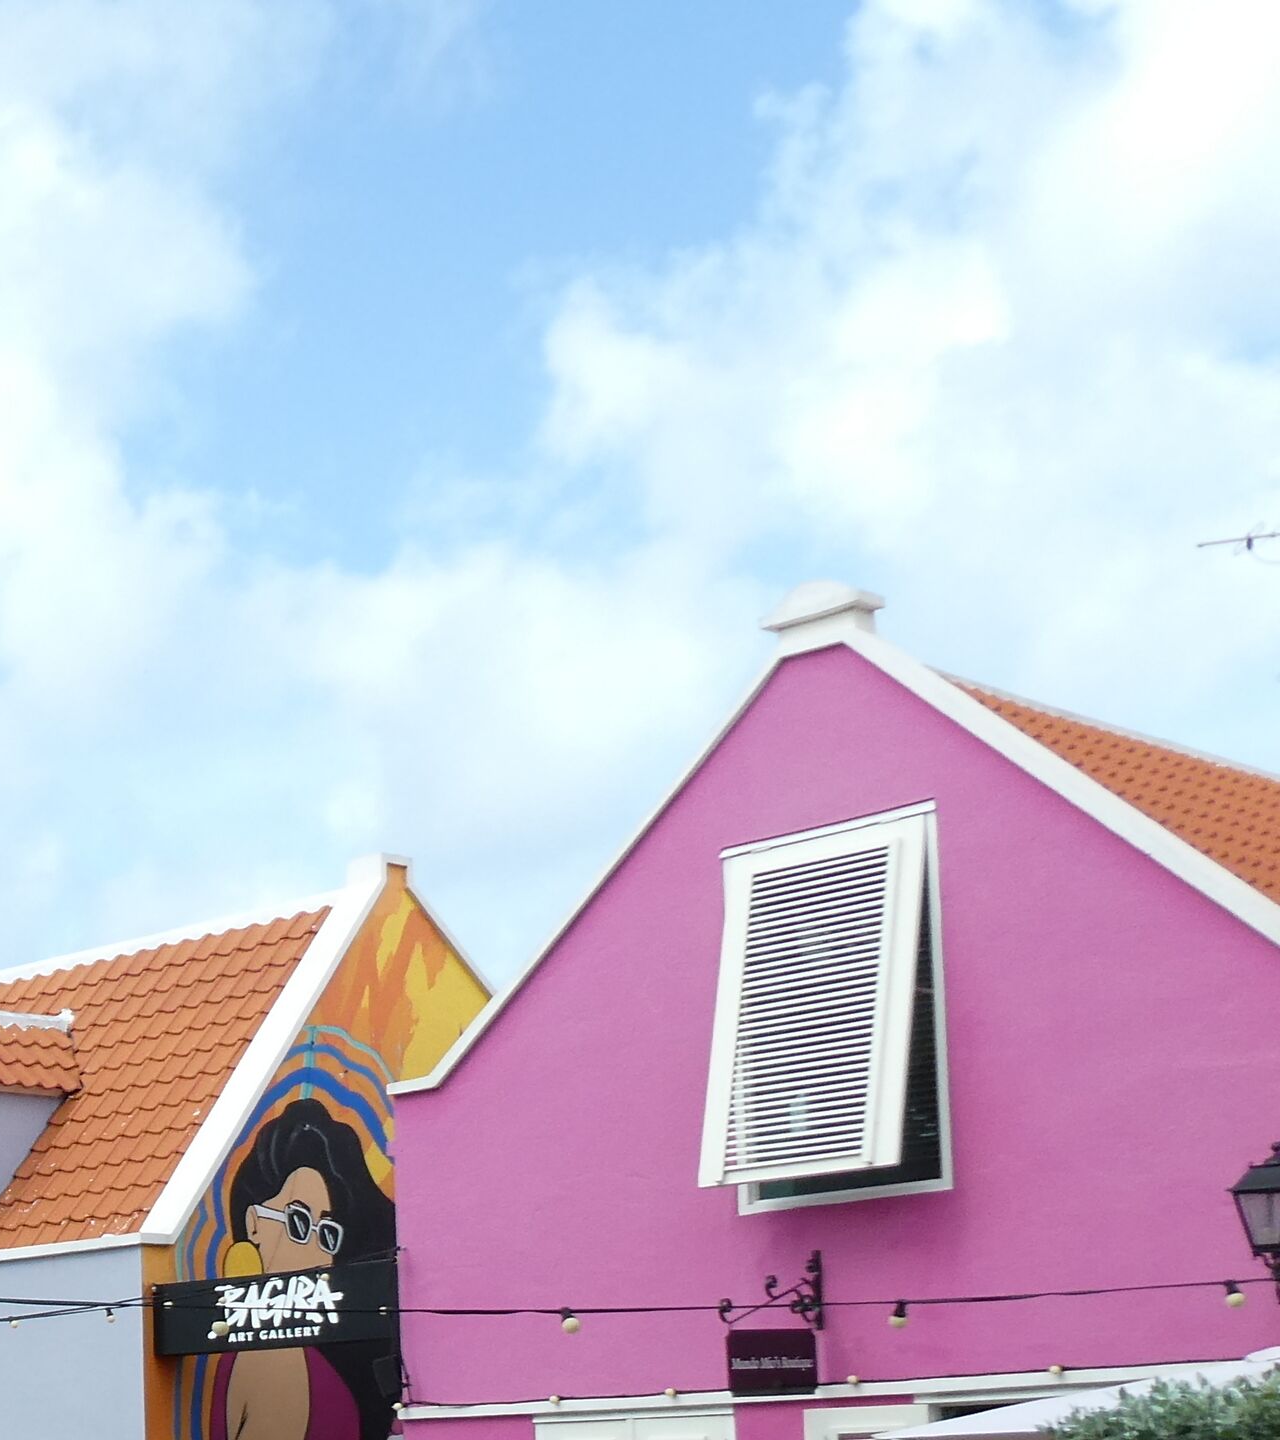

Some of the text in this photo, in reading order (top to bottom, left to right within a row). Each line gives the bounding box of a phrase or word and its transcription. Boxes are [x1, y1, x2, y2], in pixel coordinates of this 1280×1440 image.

[214, 1275, 344, 1329] BAGIRA
[228, 1326, 321, 1343] ART GALLERY
